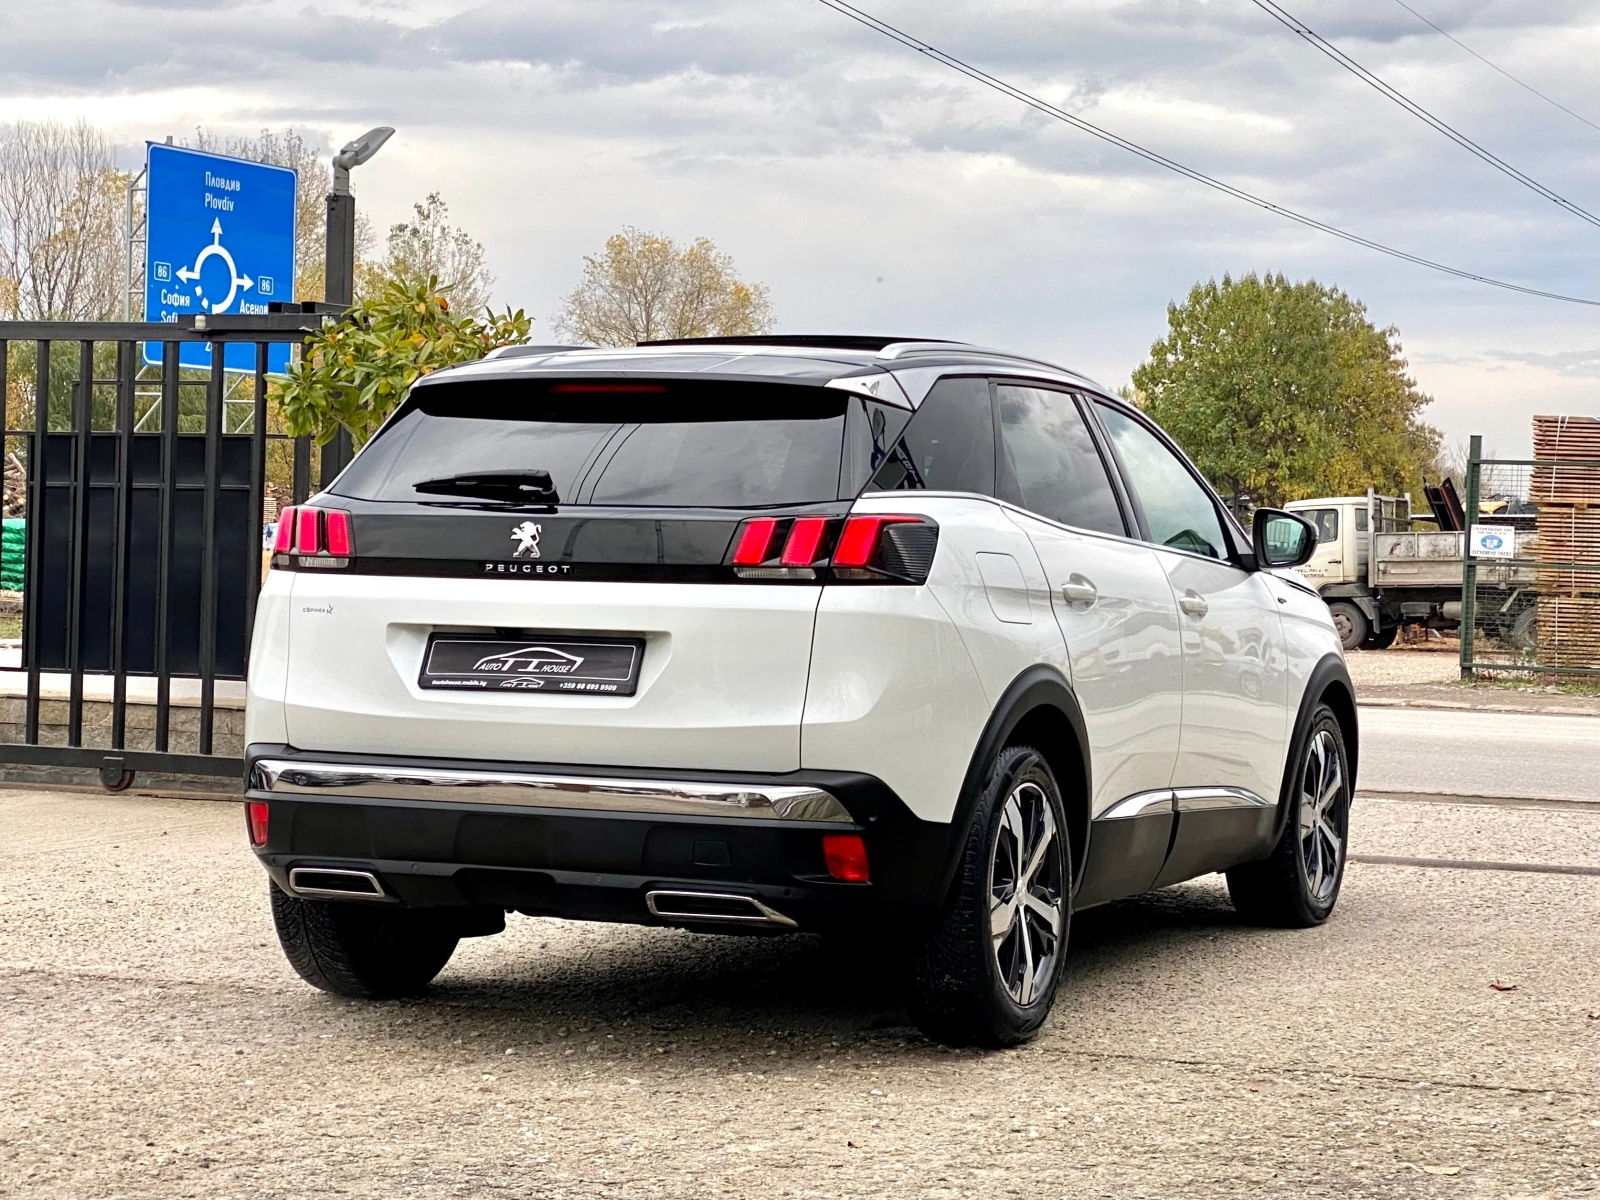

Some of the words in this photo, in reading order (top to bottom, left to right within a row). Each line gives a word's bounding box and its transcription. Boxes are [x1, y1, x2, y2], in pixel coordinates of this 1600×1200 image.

[205, 171, 241, 191] Пловдив
[204, 192, 234, 212] Plovdiv
[157, 266, 168, 278] 86
[261, 281, 270, 292] 86
[160, 288, 190, 307] София
[239, 299, 269, 315] Асенов
[160, 310, 178, 323] Sofi
[485, 563, 570, 573] PEUGEOT
[478, 662, 502, 671] AUTO
[541, 664, 571, 673] HOUSE
